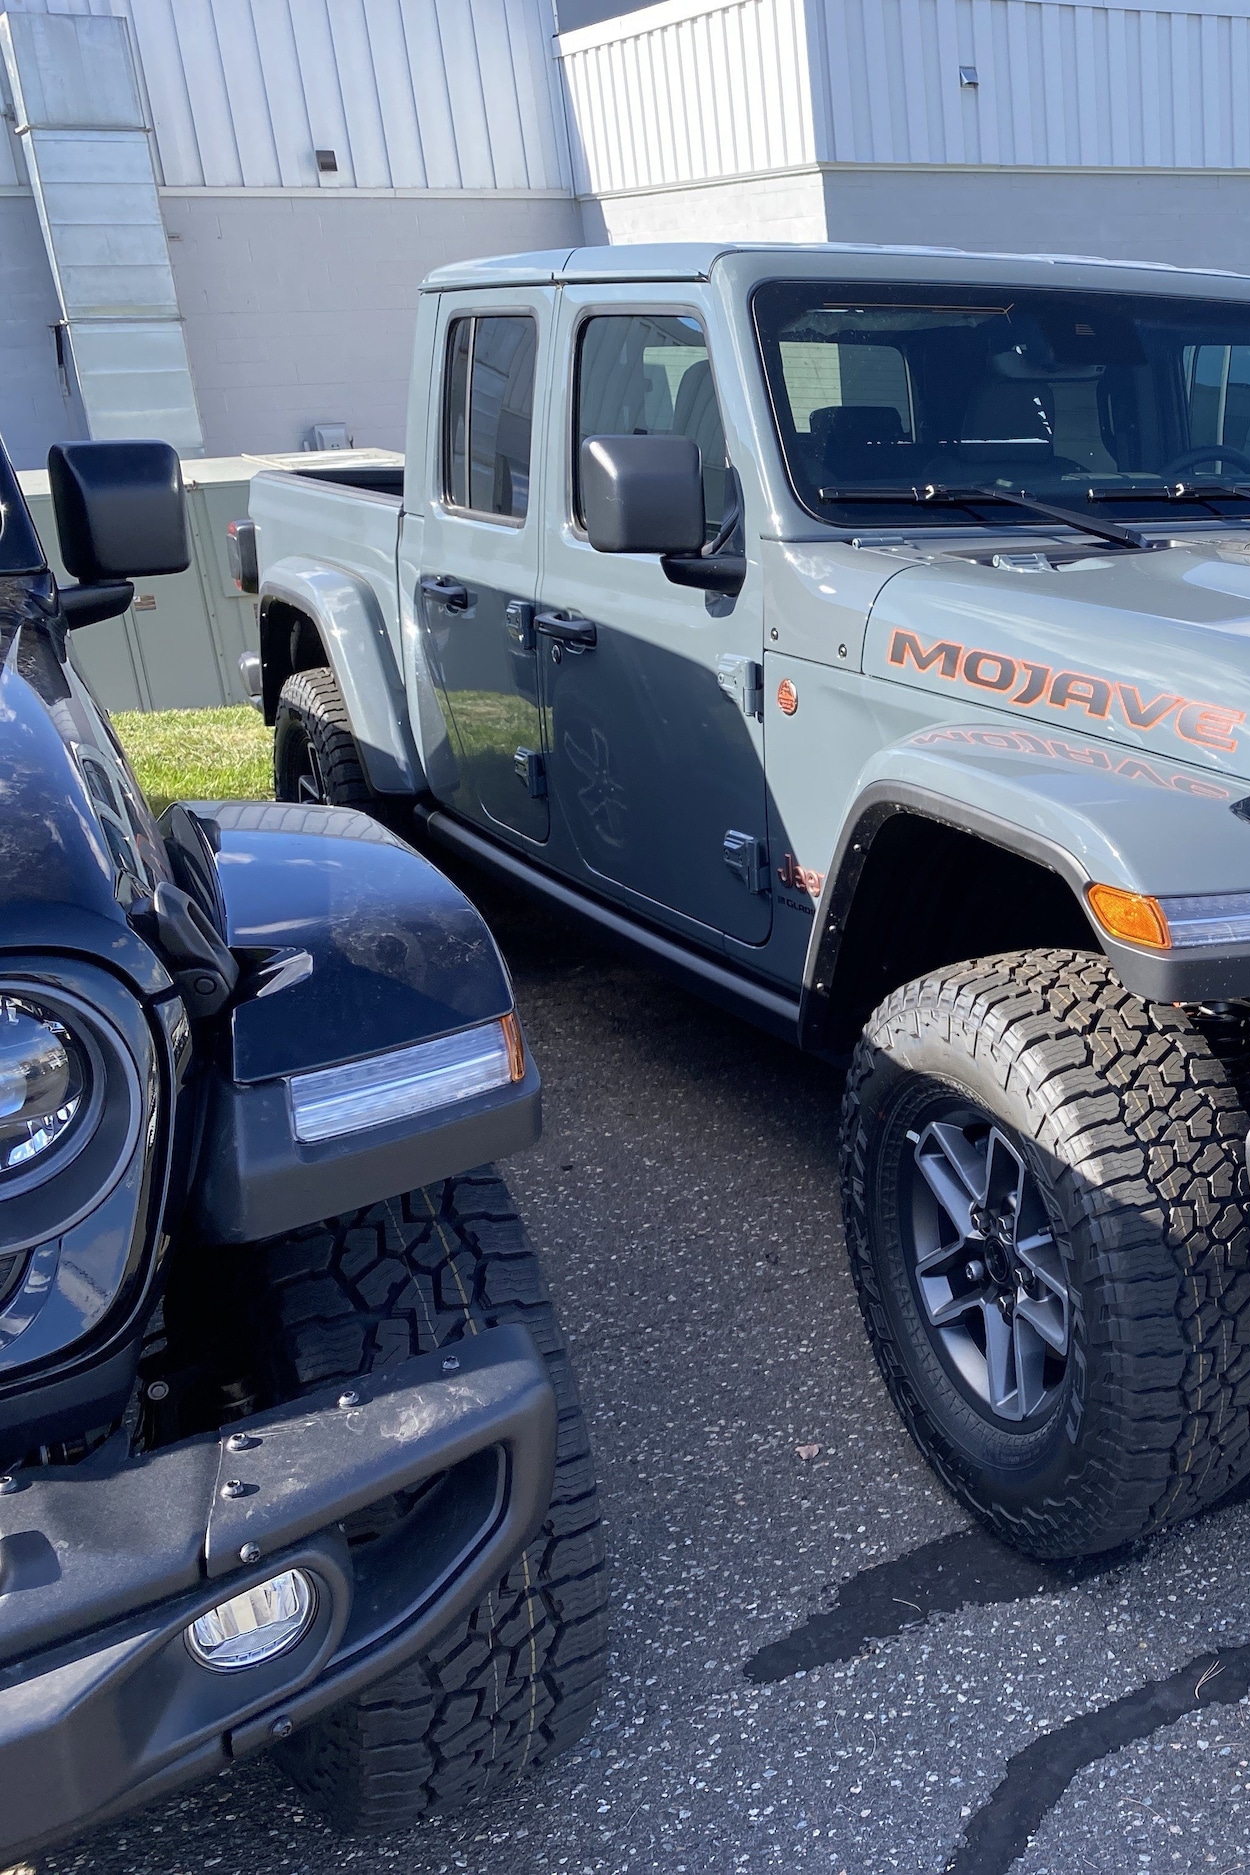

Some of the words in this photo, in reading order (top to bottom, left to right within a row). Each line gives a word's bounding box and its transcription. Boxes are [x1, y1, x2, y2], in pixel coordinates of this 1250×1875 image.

[887, 627, 1247, 753] MOJAVE
[777, 853, 825, 897] Jee
[786, 898, 816, 916] GLADI
